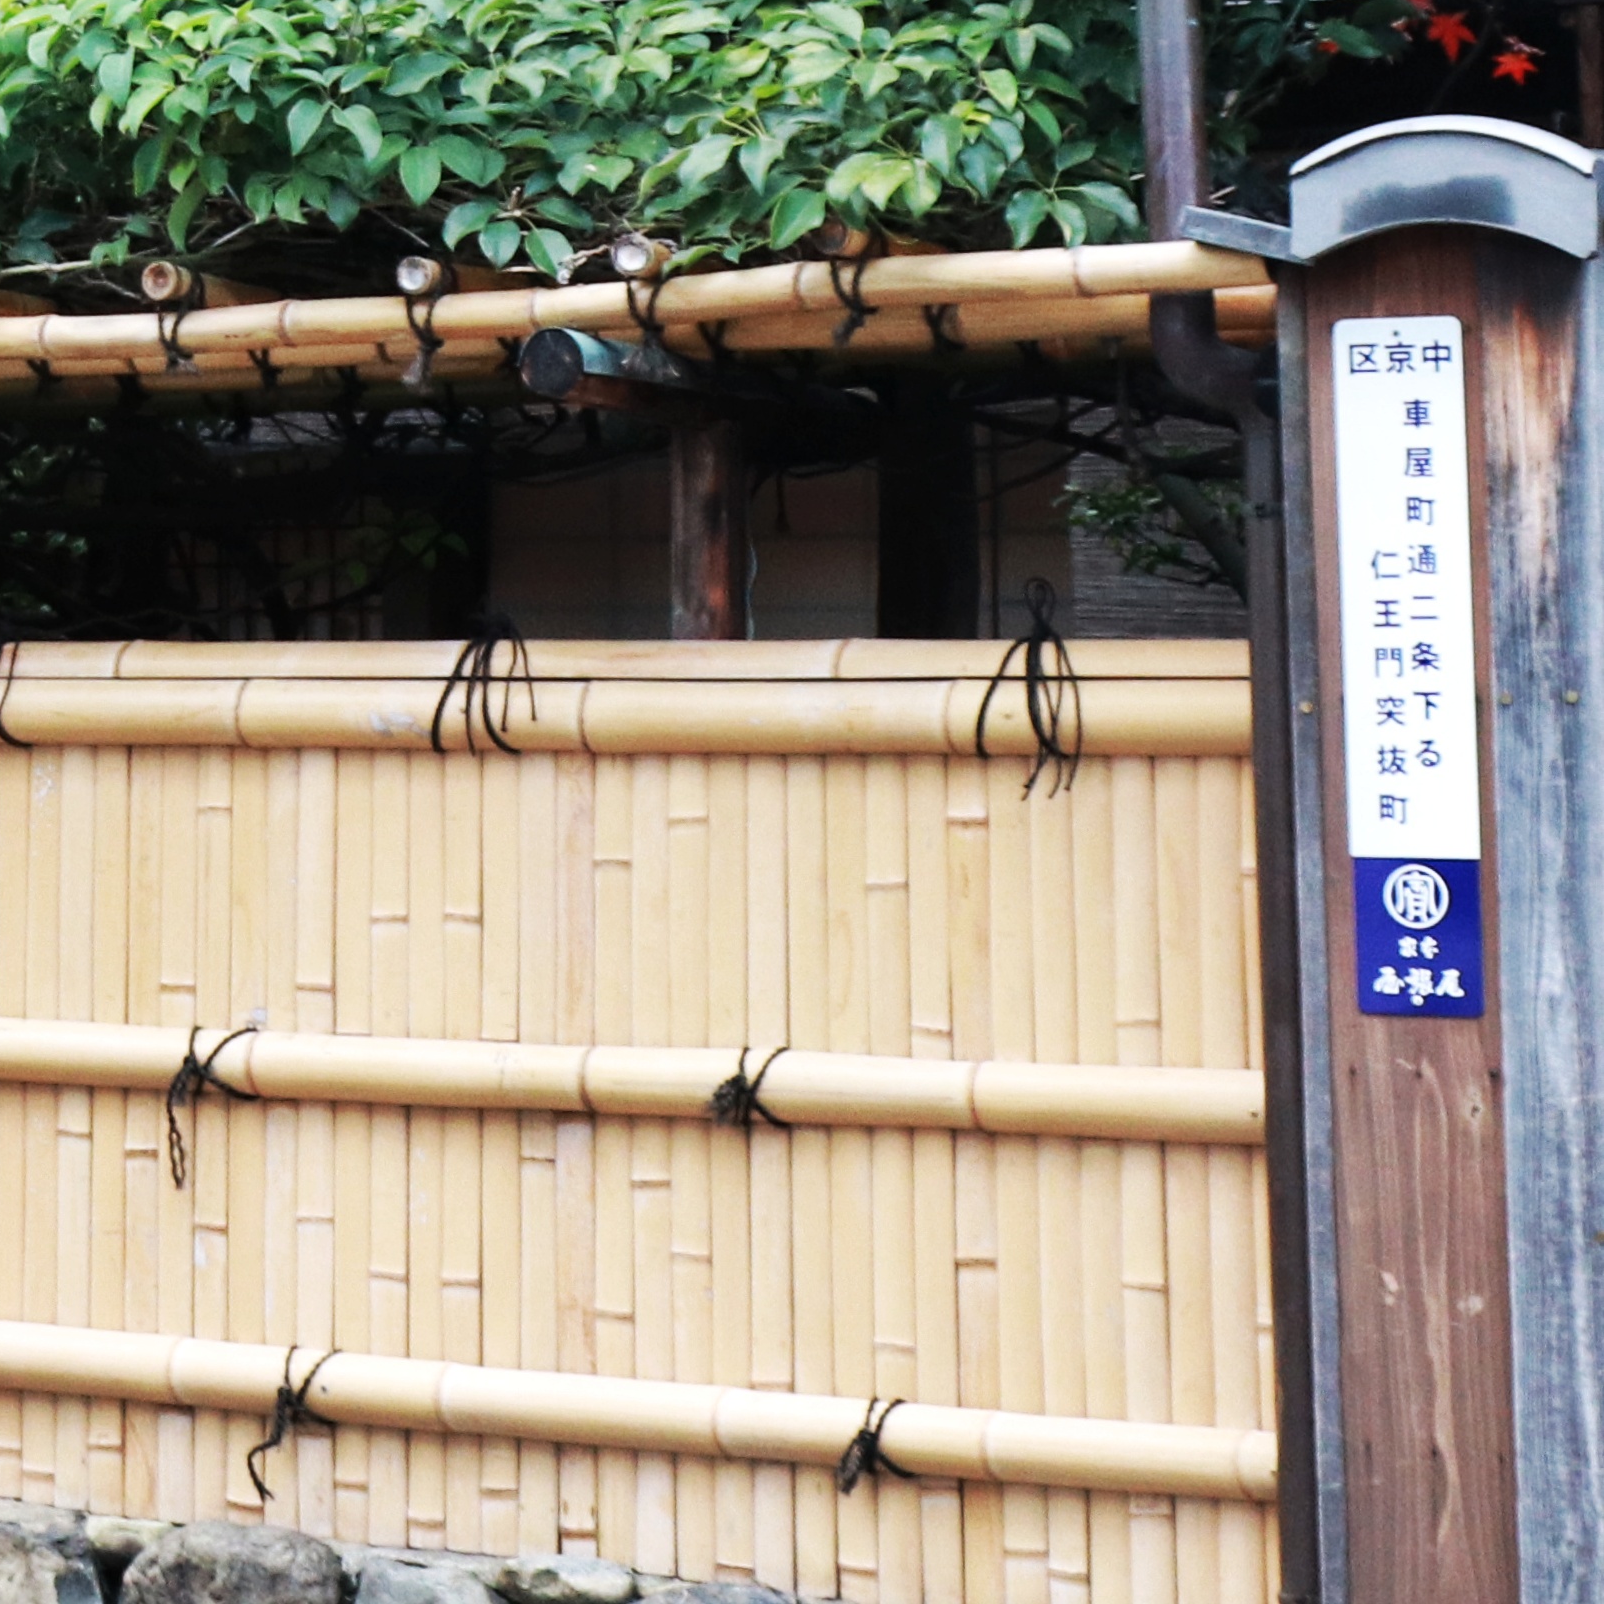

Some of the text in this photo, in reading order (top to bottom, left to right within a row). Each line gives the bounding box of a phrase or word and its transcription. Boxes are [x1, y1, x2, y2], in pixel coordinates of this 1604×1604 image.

[1349, 339, 1454, 374] 中京区
[1370, 549, 1409, 826] 仁王門突抜町
[1401, 398, 1442, 770] 車屋町通二条下る
